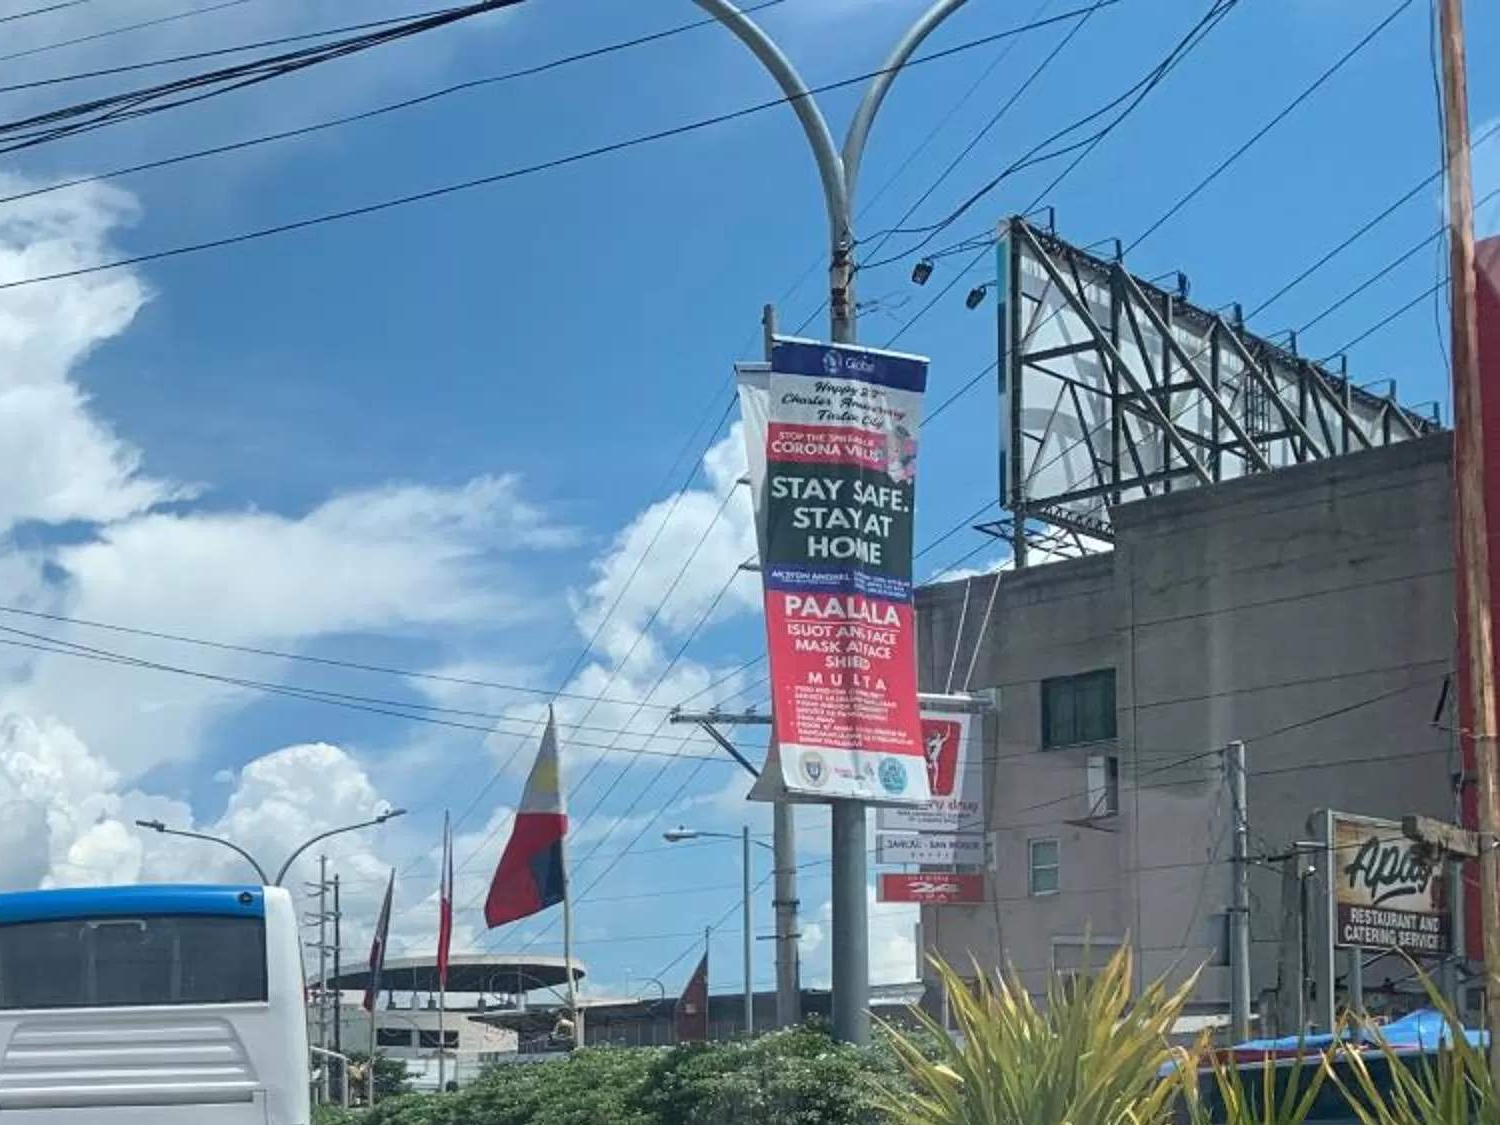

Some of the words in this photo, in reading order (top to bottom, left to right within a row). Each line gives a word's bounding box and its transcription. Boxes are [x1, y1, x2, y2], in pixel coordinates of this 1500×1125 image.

[771, 440, 841, 457] CORONA
[771, 475, 844, 500] STAY
[853, 480, 909, 513] SAFE.
[792, 506, 862, 529] STAY
[863, 513, 893, 538] AT
[807, 535, 882, 565] HOME
[784, 594, 901, 627] PAALALA
[787, 623, 833, 638] ISUOT
[867, 631, 897, 645] FACE
[795, 639, 842, 653] MASK
[863, 645, 893, 659] FACE
[1350, 908, 1417, 930] RESTAURANT
[1420, 915, 1441, 933] AND
[1343, 925, 1397, 945] CATERING
